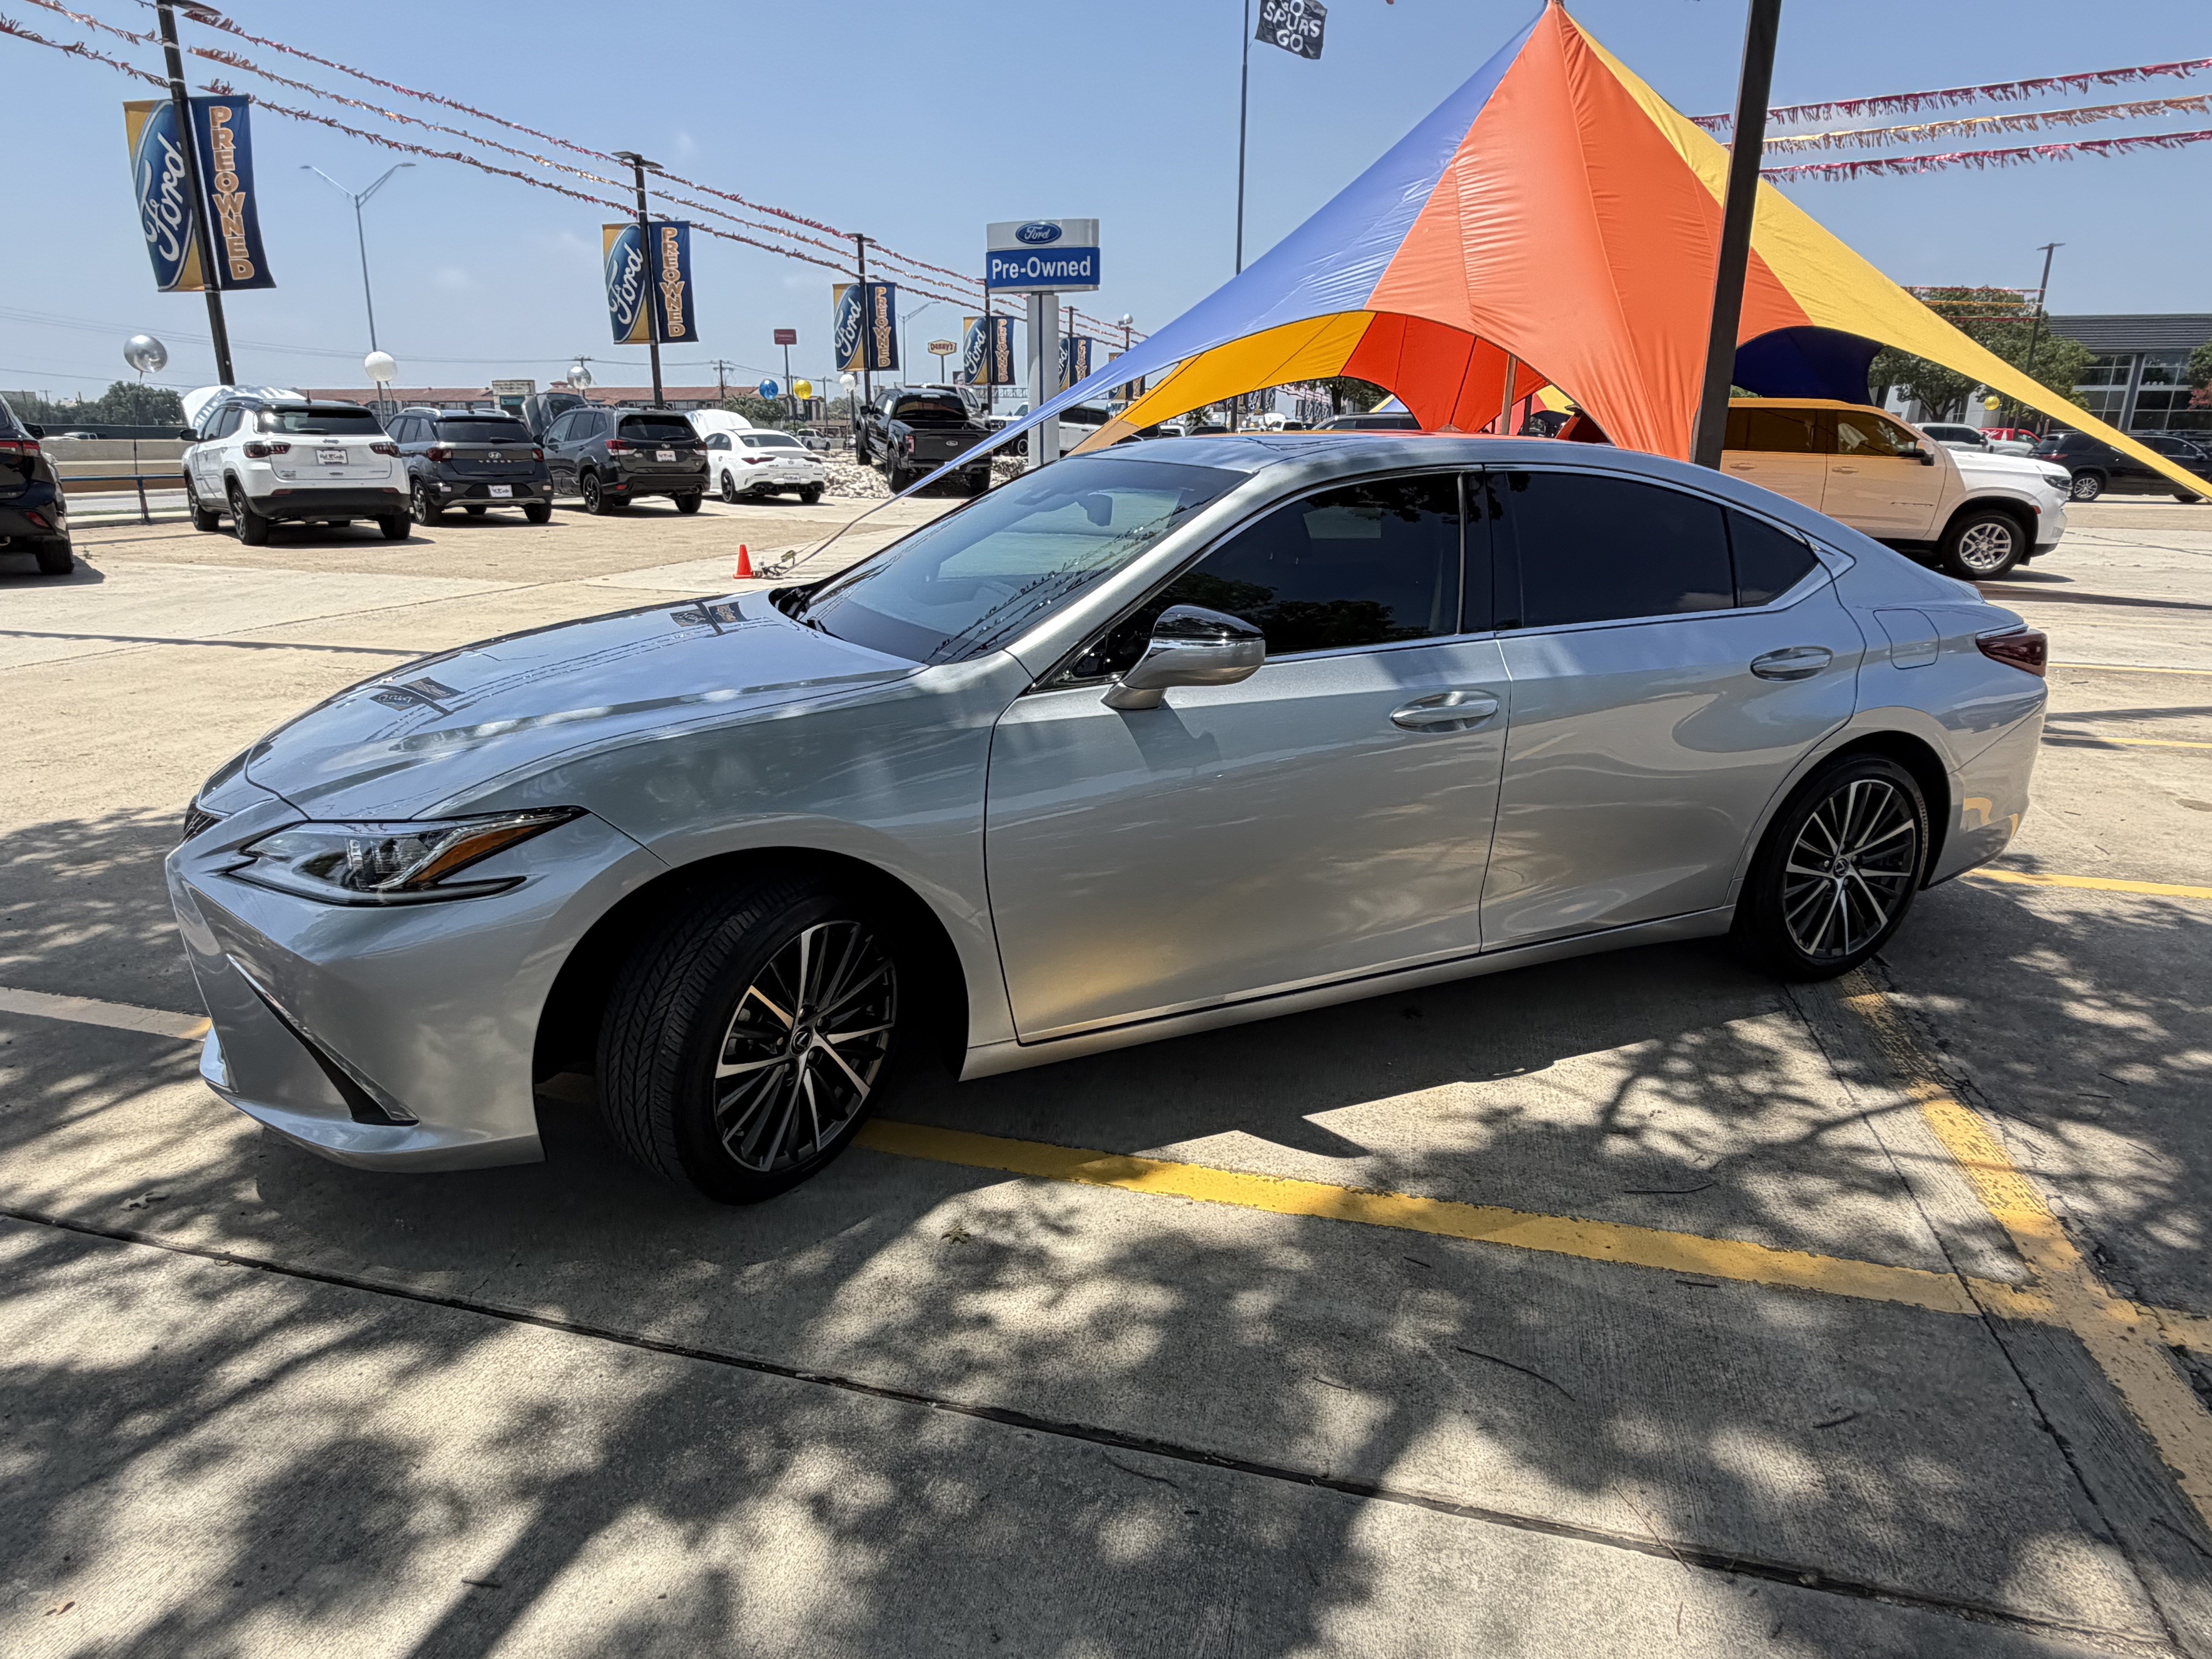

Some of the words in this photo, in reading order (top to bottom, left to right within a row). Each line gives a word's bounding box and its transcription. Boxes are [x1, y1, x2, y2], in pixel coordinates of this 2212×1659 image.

[1263, 2, 1321, 38] SPURS
[1277, 29, 1303, 52] GO
[140, 132, 186, 261] Ford
[209, 106, 254, 280] PREOWNED
[1024, 227, 1051, 240] Ford
[608, 242, 644, 325] Ford
[659, 227, 685, 337] PREOWNED
[992, 256, 1091, 280] Pre-Owned
[835, 297, 862, 357] Ford
[964, 327, 986, 374] Ford
